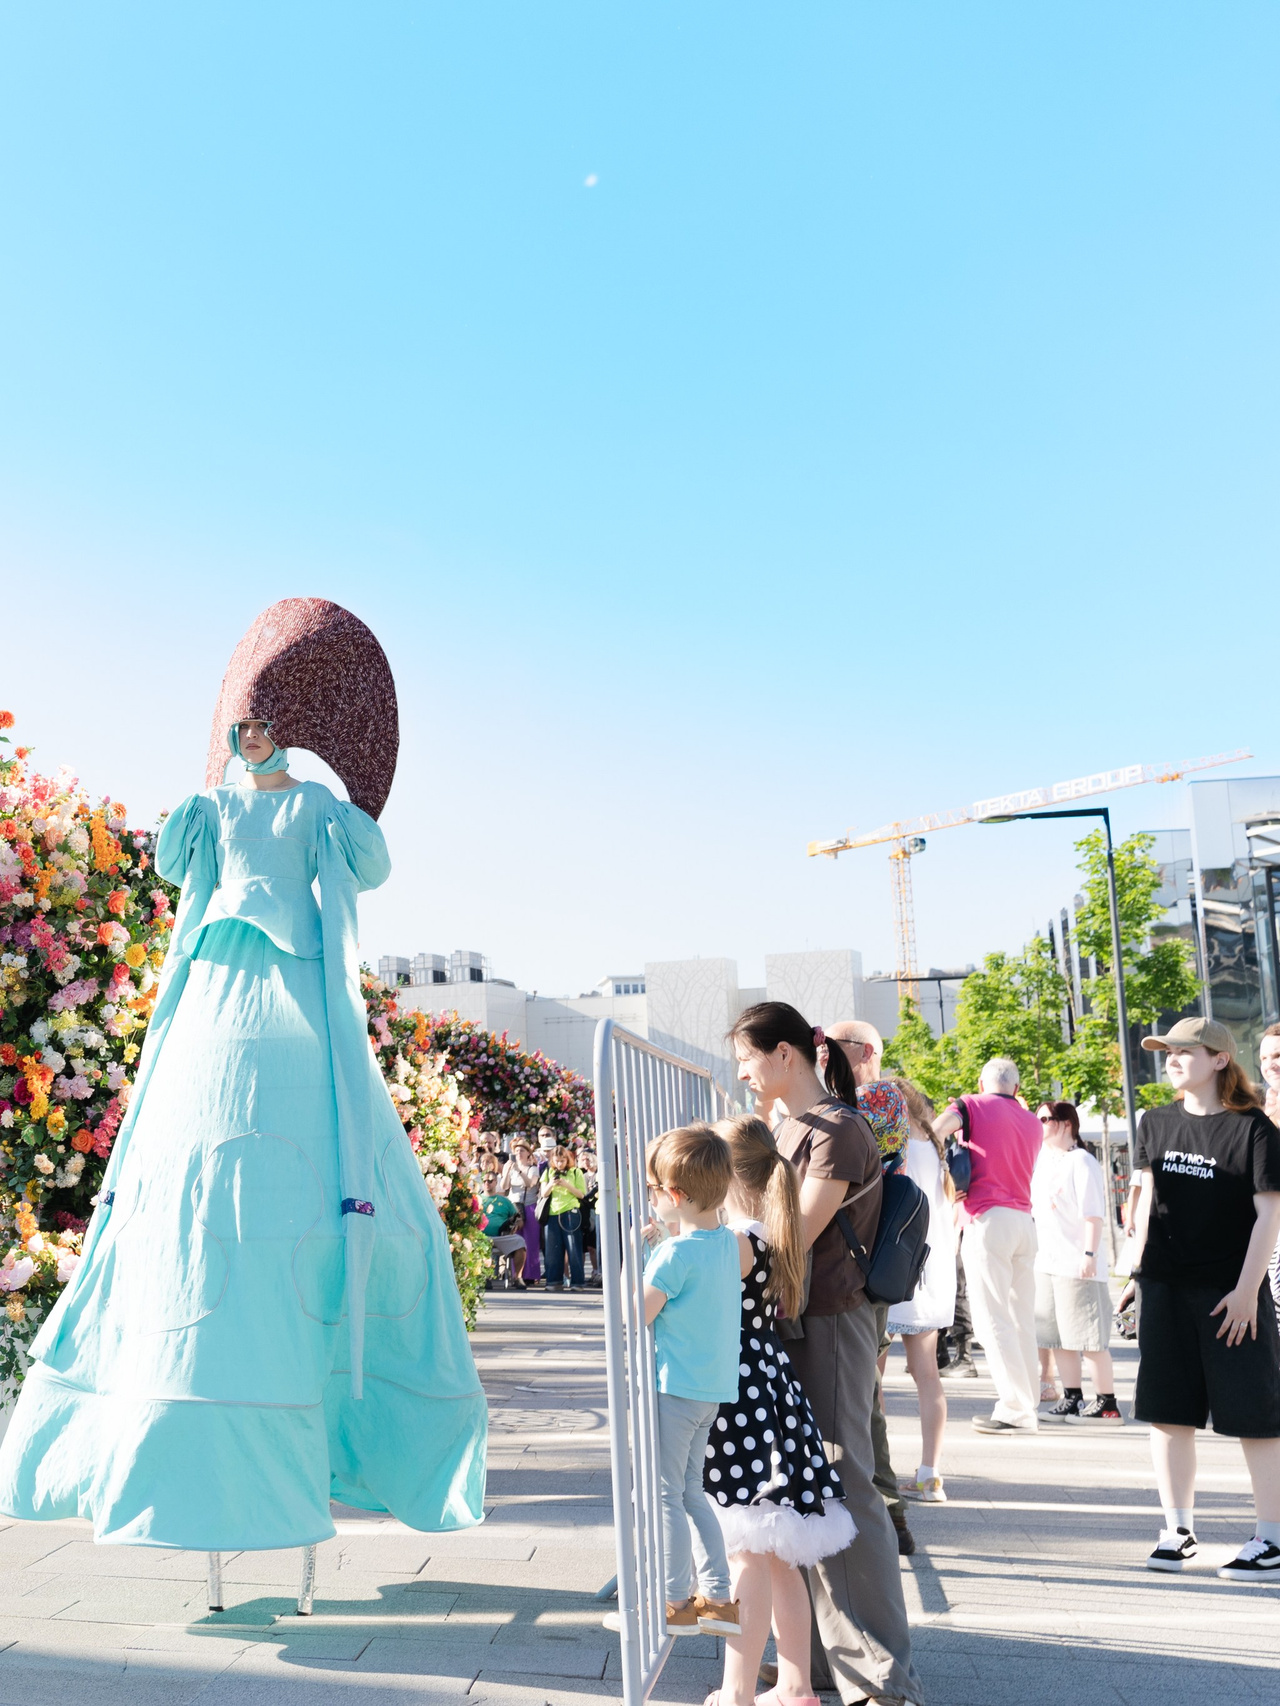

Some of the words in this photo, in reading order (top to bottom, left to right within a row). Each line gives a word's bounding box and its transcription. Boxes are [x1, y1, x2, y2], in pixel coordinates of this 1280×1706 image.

[972, 787, 1044, 818] TEKTA
[1052, 764, 1144, 800] GROUP
[1164, 1150, 1205, 1165] ИГУМО
[1162, 1162, 1214, 1179] НАВСЕГДА
